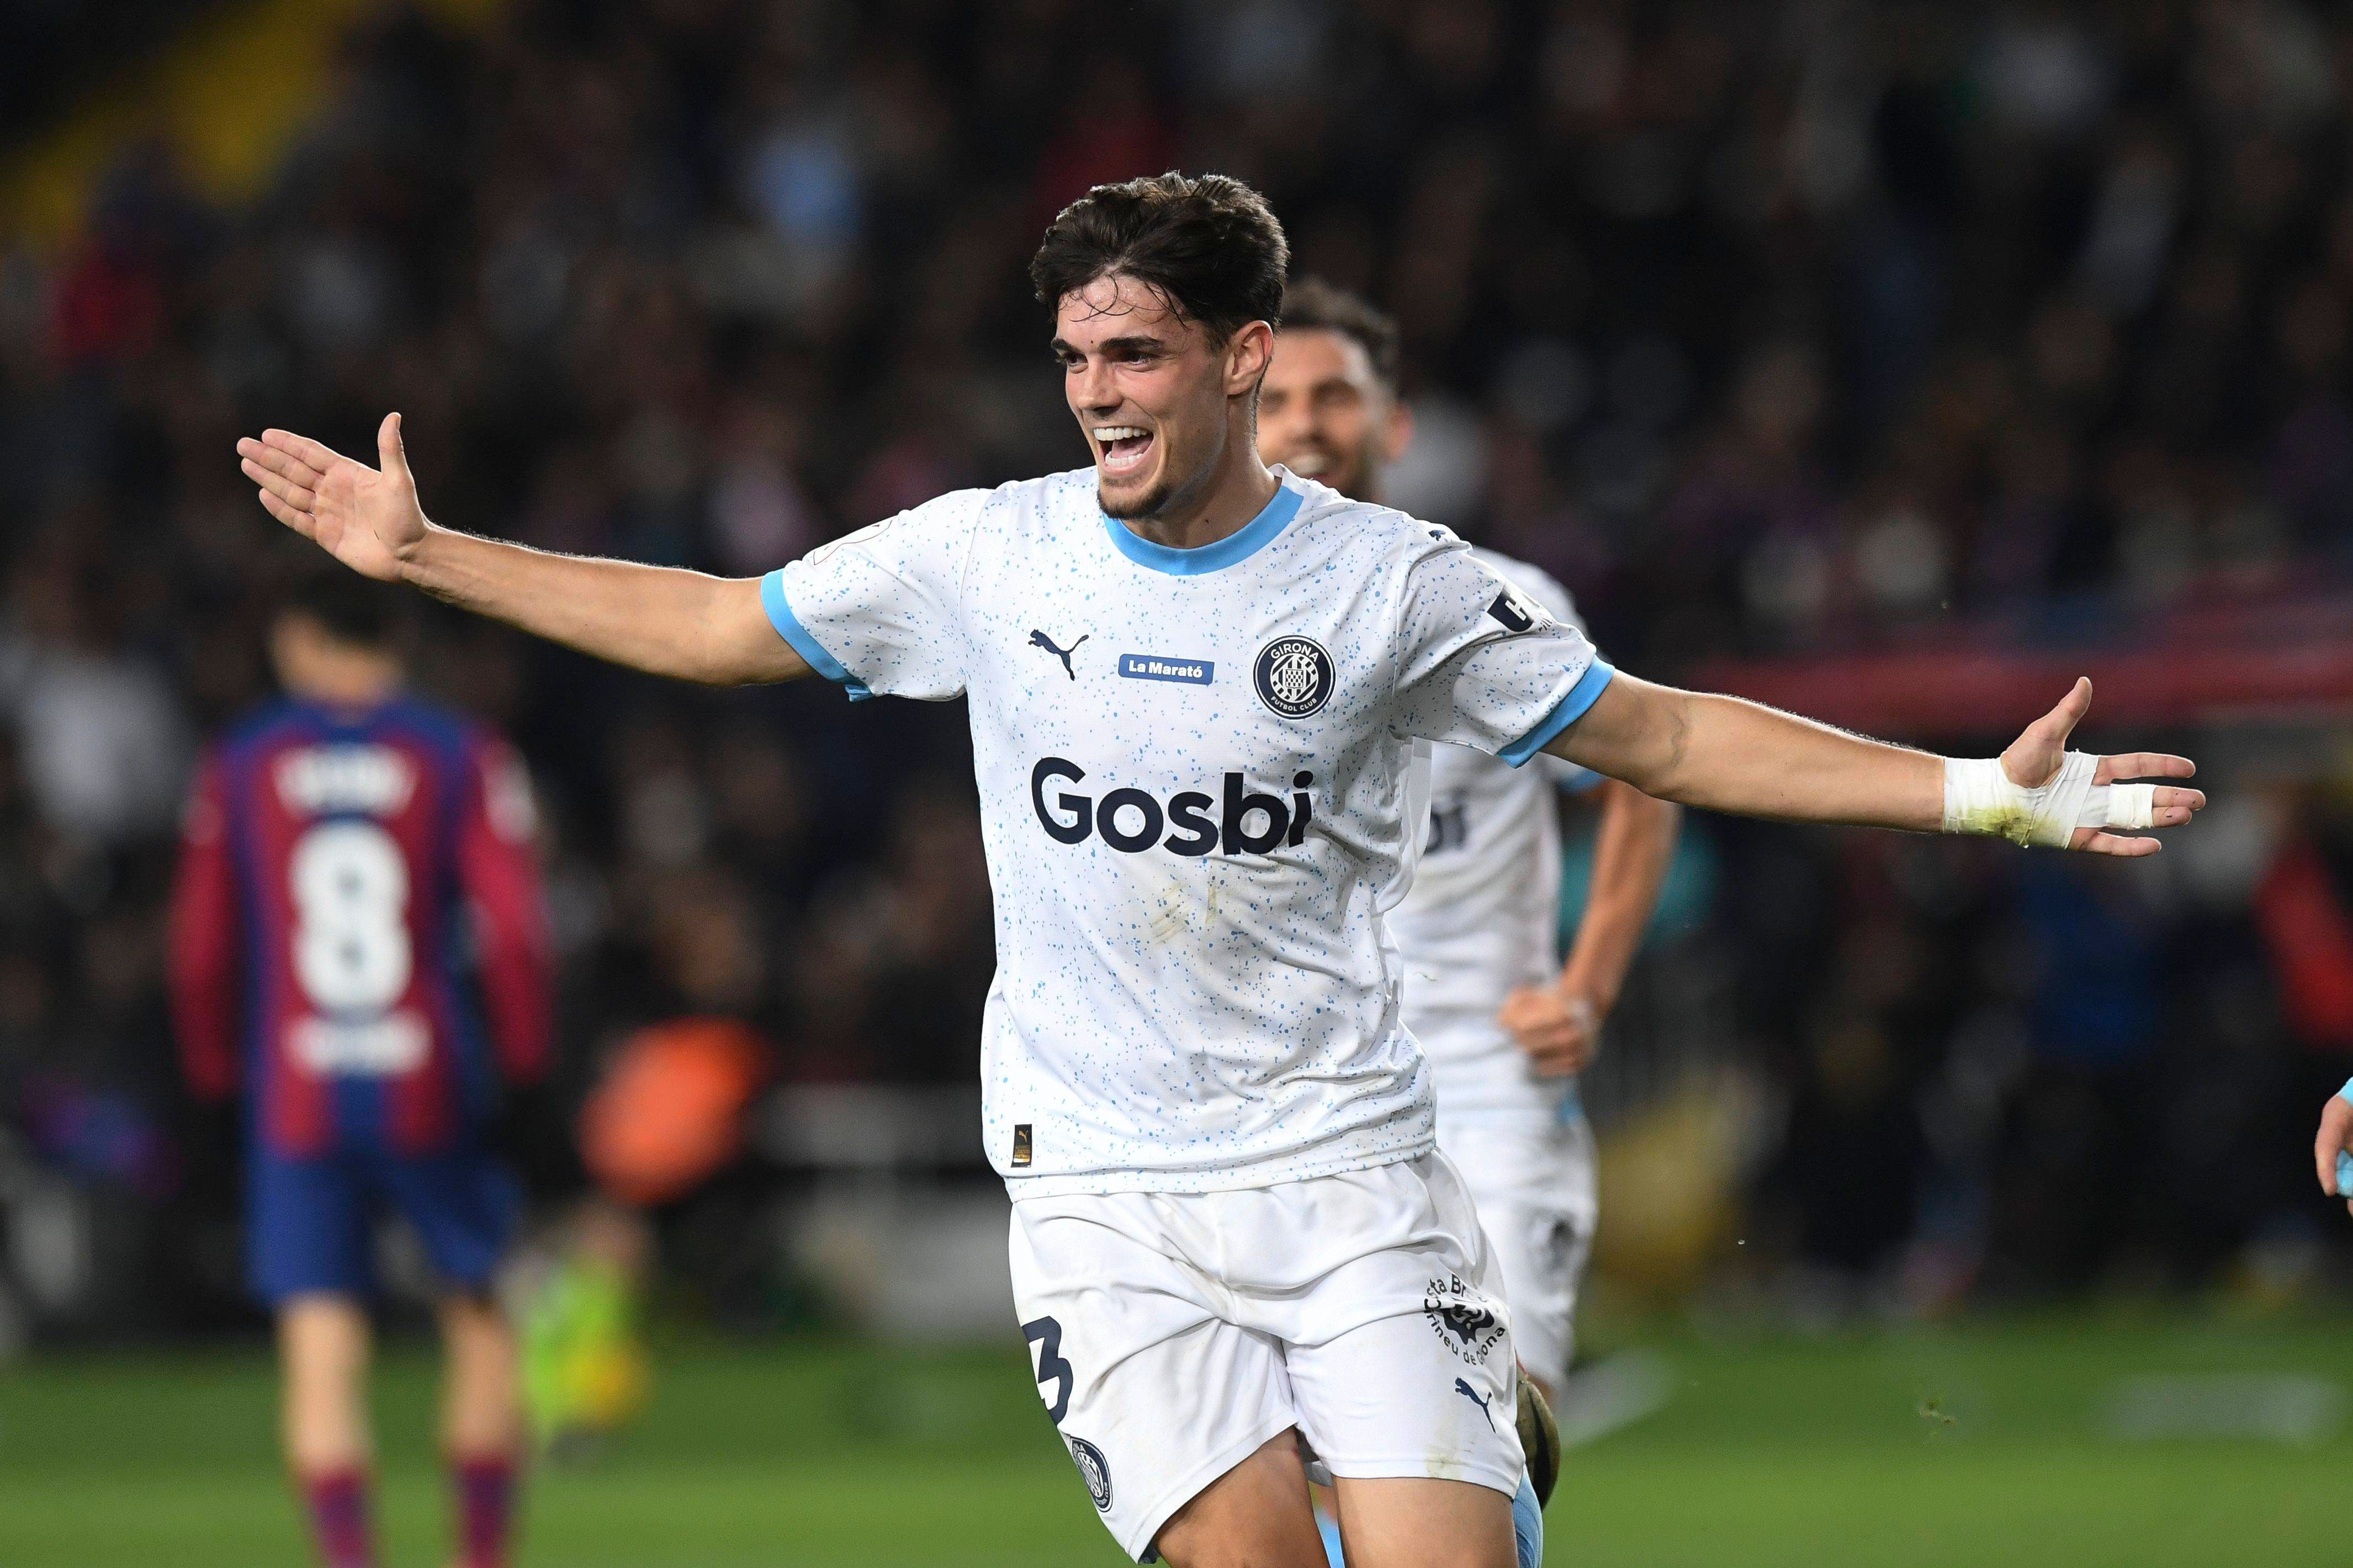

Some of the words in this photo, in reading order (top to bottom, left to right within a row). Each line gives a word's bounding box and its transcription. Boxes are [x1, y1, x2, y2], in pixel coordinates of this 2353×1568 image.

[1270, 642, 1319, 663] GIRONA
[1128, 660, 1146, 673] La
[1148, 662, 1203, 678] Marató
[1270, 696, 1298, 712] FUTBOL
[1300, 698, 1317, 711] CLUB
[1031, 756, 1314, 857] Gosbi
[291, 821, 412, 1017] 8
